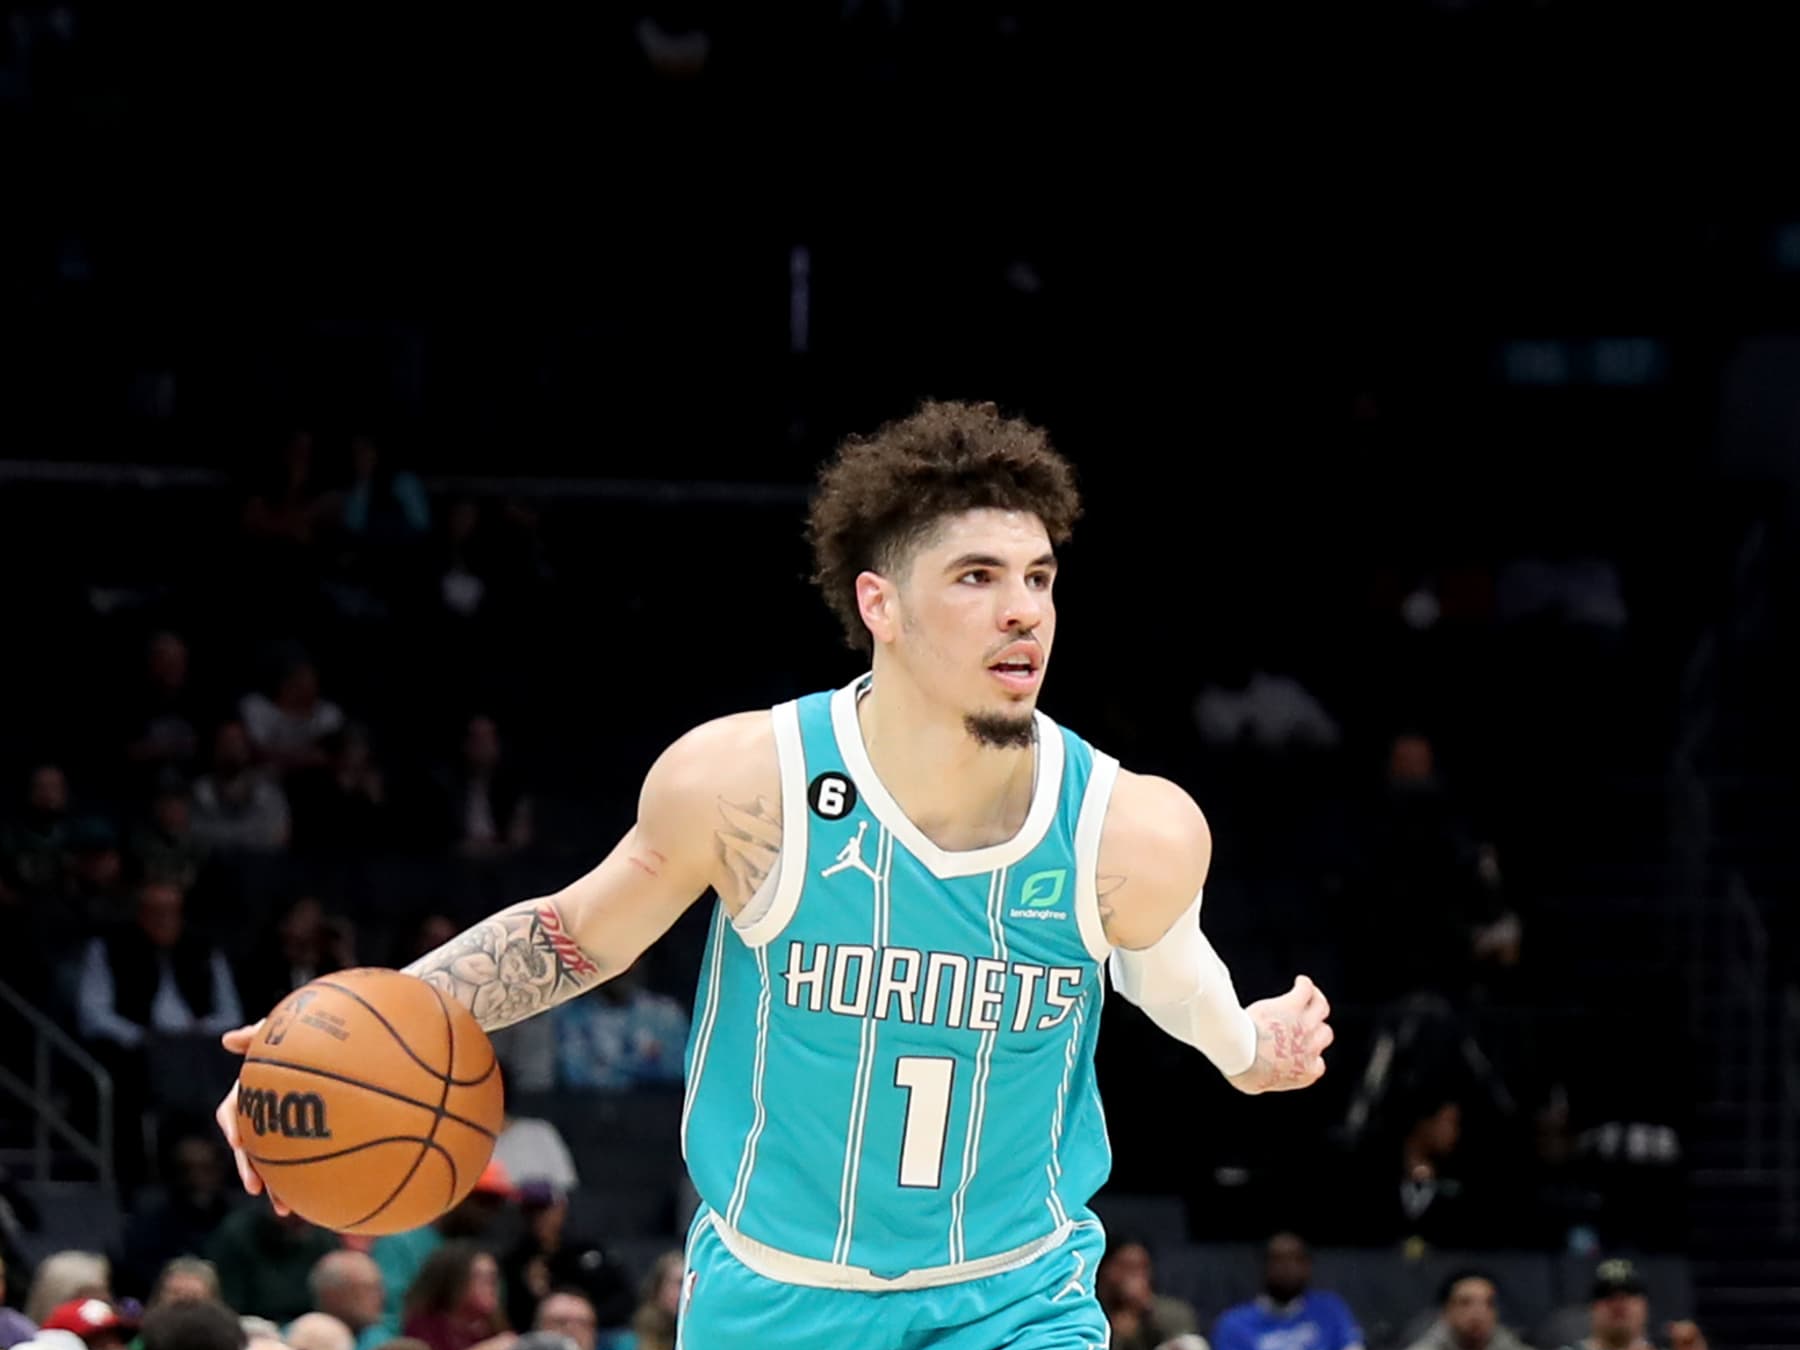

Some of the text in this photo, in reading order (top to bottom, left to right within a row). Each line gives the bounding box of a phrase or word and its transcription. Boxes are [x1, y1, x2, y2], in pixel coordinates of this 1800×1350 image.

[818, 778, 847, 815] 6
[1009, 908, 1067, 921] lendingtree
[784, 942, 1082, 1032] HORNETS
[238, 1083, 331, 1138] Wils
[894, 1056, 956, 1189] 1
